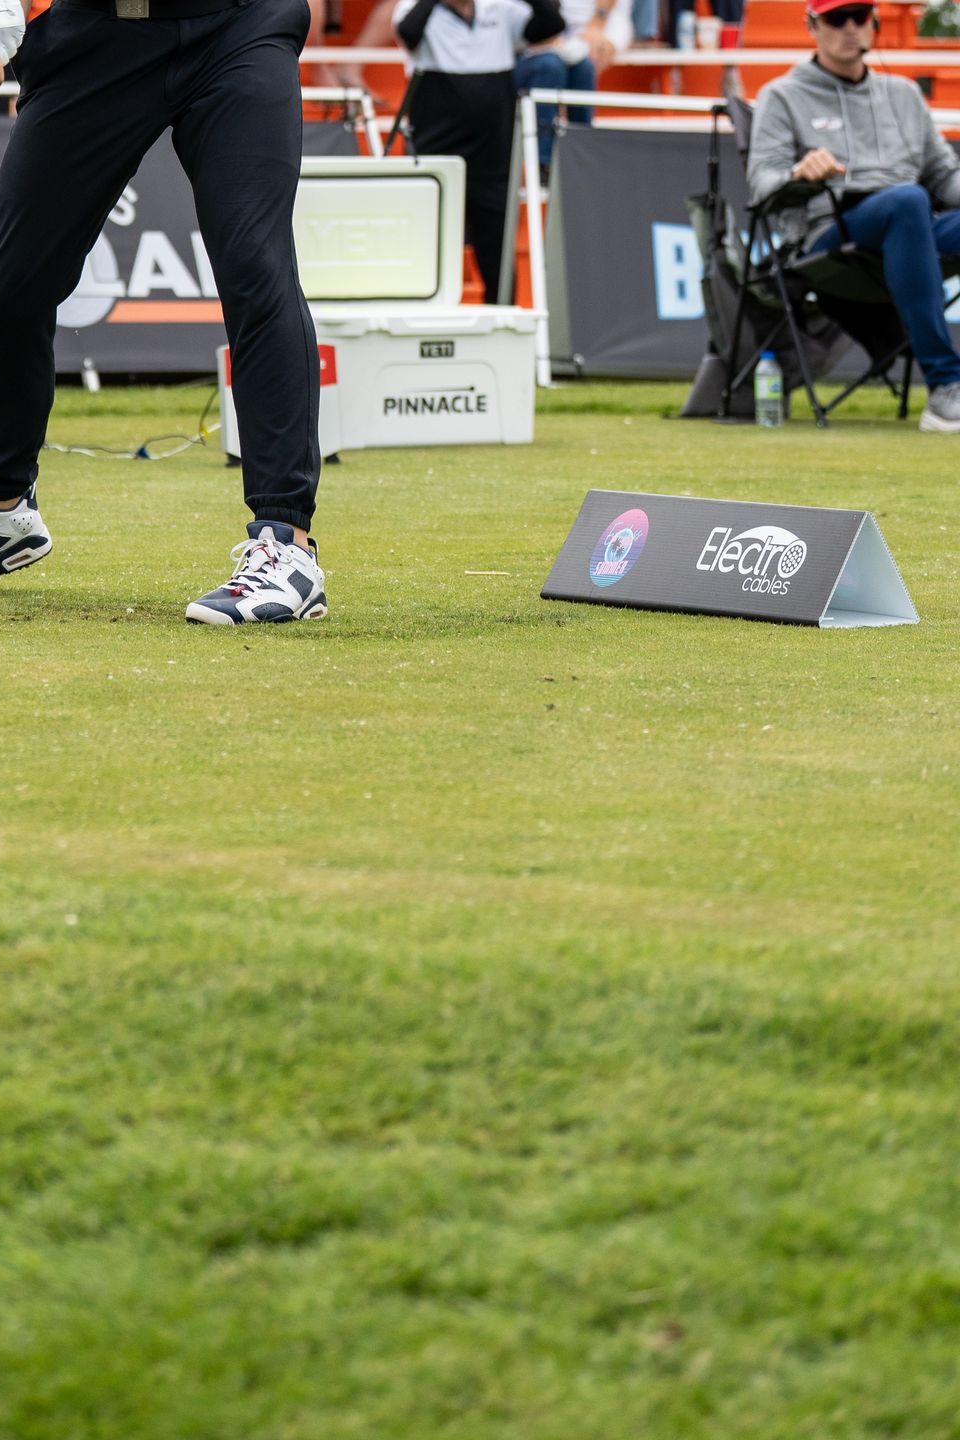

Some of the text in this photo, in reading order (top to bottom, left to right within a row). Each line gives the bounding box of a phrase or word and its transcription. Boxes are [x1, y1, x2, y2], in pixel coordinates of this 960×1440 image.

[421, 342, 454, 358] YETI
[383, 395, 487, 416] PINNACLE
[696, 526, 807, 579] Electro
[742, 573, 790, 596] cables
